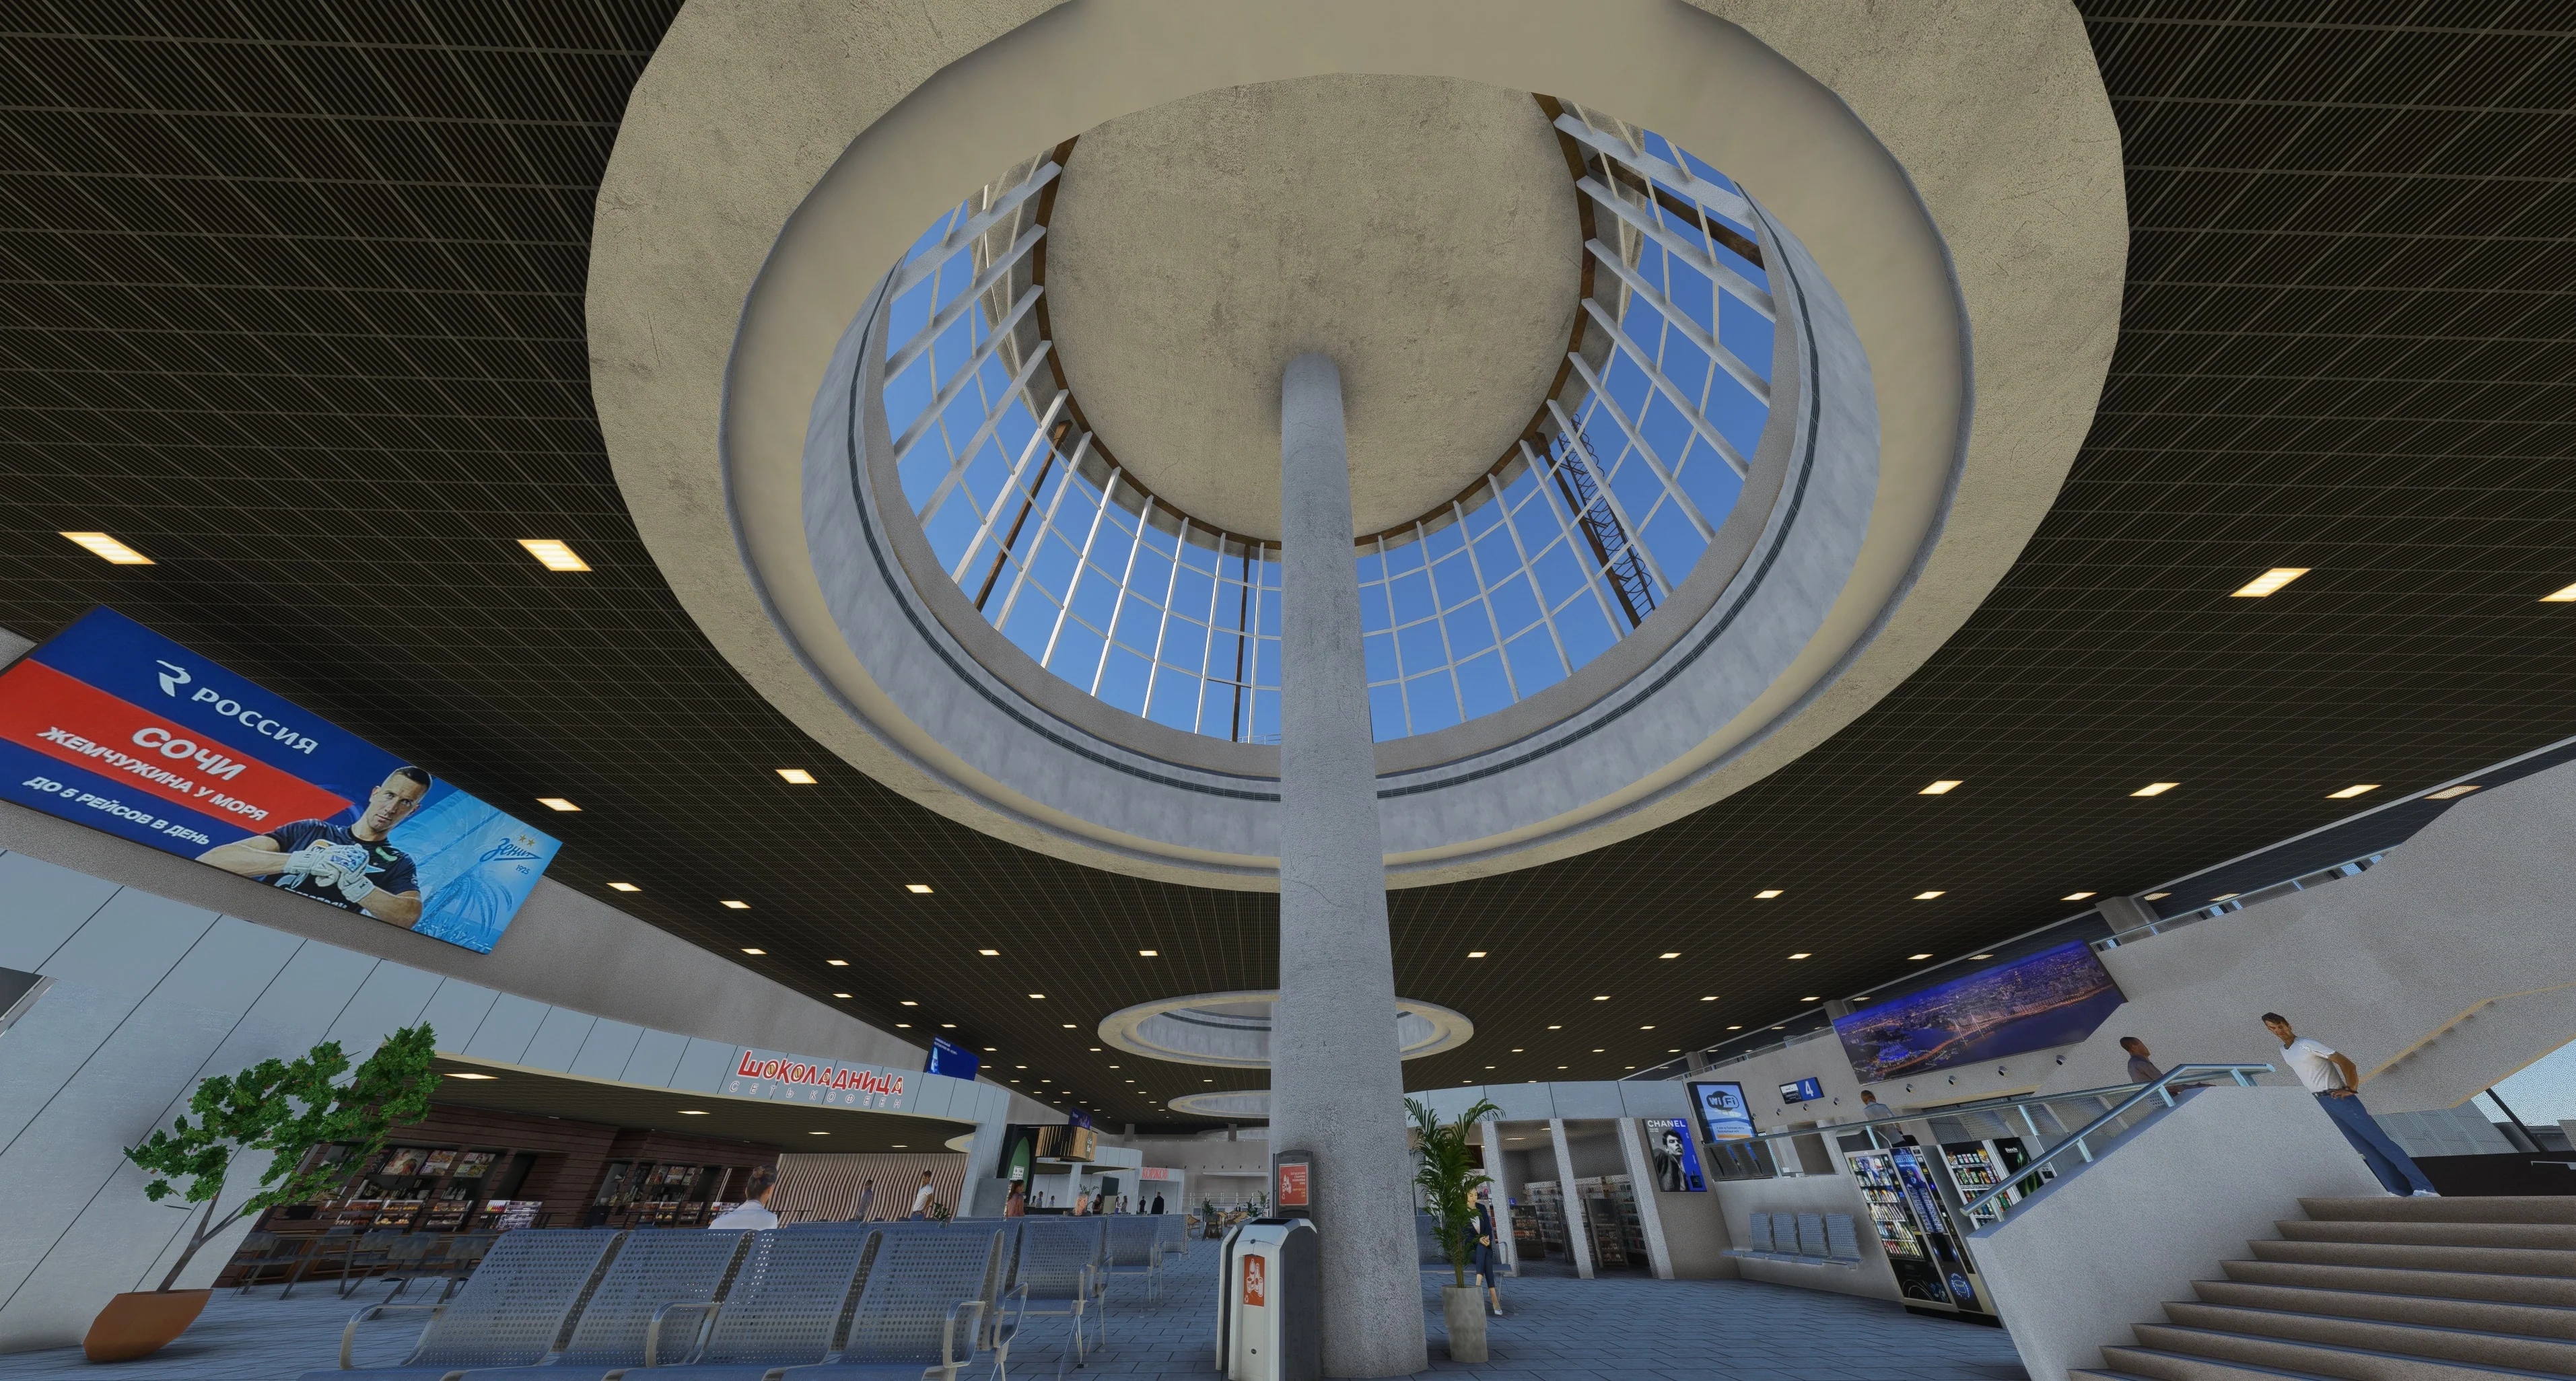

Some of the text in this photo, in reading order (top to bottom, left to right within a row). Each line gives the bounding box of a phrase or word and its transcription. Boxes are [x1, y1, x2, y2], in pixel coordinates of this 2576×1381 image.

[191, 687, 318, 754] РОССИЯ
[36, 727, 269, 820] ЖЕМЧУЖИНА У МОРЯ
[133, 728, 246, 780] СОЧИ
[22, 777, 210, 845] ДО 5 РЕЙСОВ В ДЕНЬ
[516, 865, 530, 874] 1925
[730, 1082, 901, 1108] СЕТЬ КОФЕЕН
[737, 1051, 903, 1095] ШОКОЛАДНИЦА
[1805, 1081, 1813, 1096] 4
[1142, 1168, 1168, 1179] КОРЖОВ
